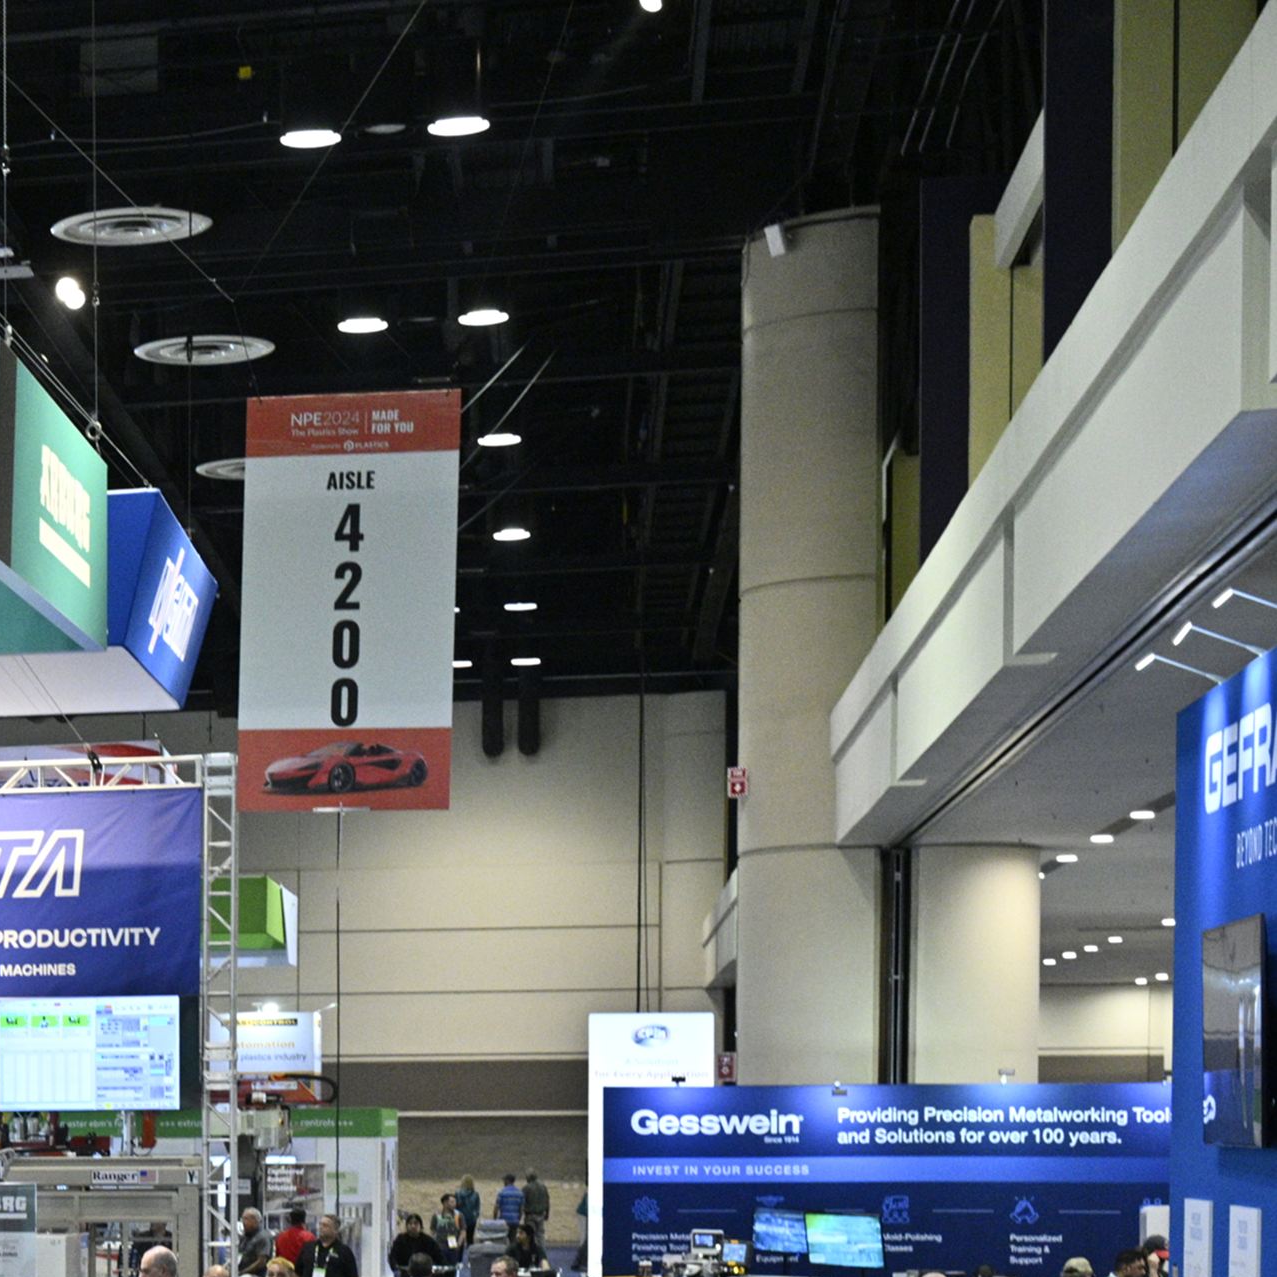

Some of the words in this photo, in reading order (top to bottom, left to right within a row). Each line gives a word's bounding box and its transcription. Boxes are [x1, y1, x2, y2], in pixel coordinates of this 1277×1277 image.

[291, 411, 360, 427] NPE2024
[372, 409, 400, 421] MADE
[372, 422, 390, 434] FOR
[394, 421, 414, 433] YOU
[327, 470, 375, 490] AISLE
[0, 963, 76, 977] MACHINES
[240, 1053, 272, 1062] plastics
[274, 1053, 307, 1062] industry
[631, 1109, 801, 1136] Gesswein
[837, 1107, 919, 1126] Providing
[924, 1107, 1004, 1123] Precision
[1009, 1107, 1128, 1126] Metalworking
[837, 1128, 870, 1144] and
[875, 1128, 955, 1144] Solutions
[960, 1128, 985, 1144] for
[989, 1131, 1028, 1144] over
[1032, 1128, 1064, 1144] 100
[1069, 1131, 1122, 1147] years.
[92, 1171, 139, 1183] Ranger
[632, 1165, 679, 1176] INVEST
[685, 1165, 698, 1175] IN
[703, 1165, 741, 1176] YOUR
[745, 1165, 810, 1176] SUCCESS
